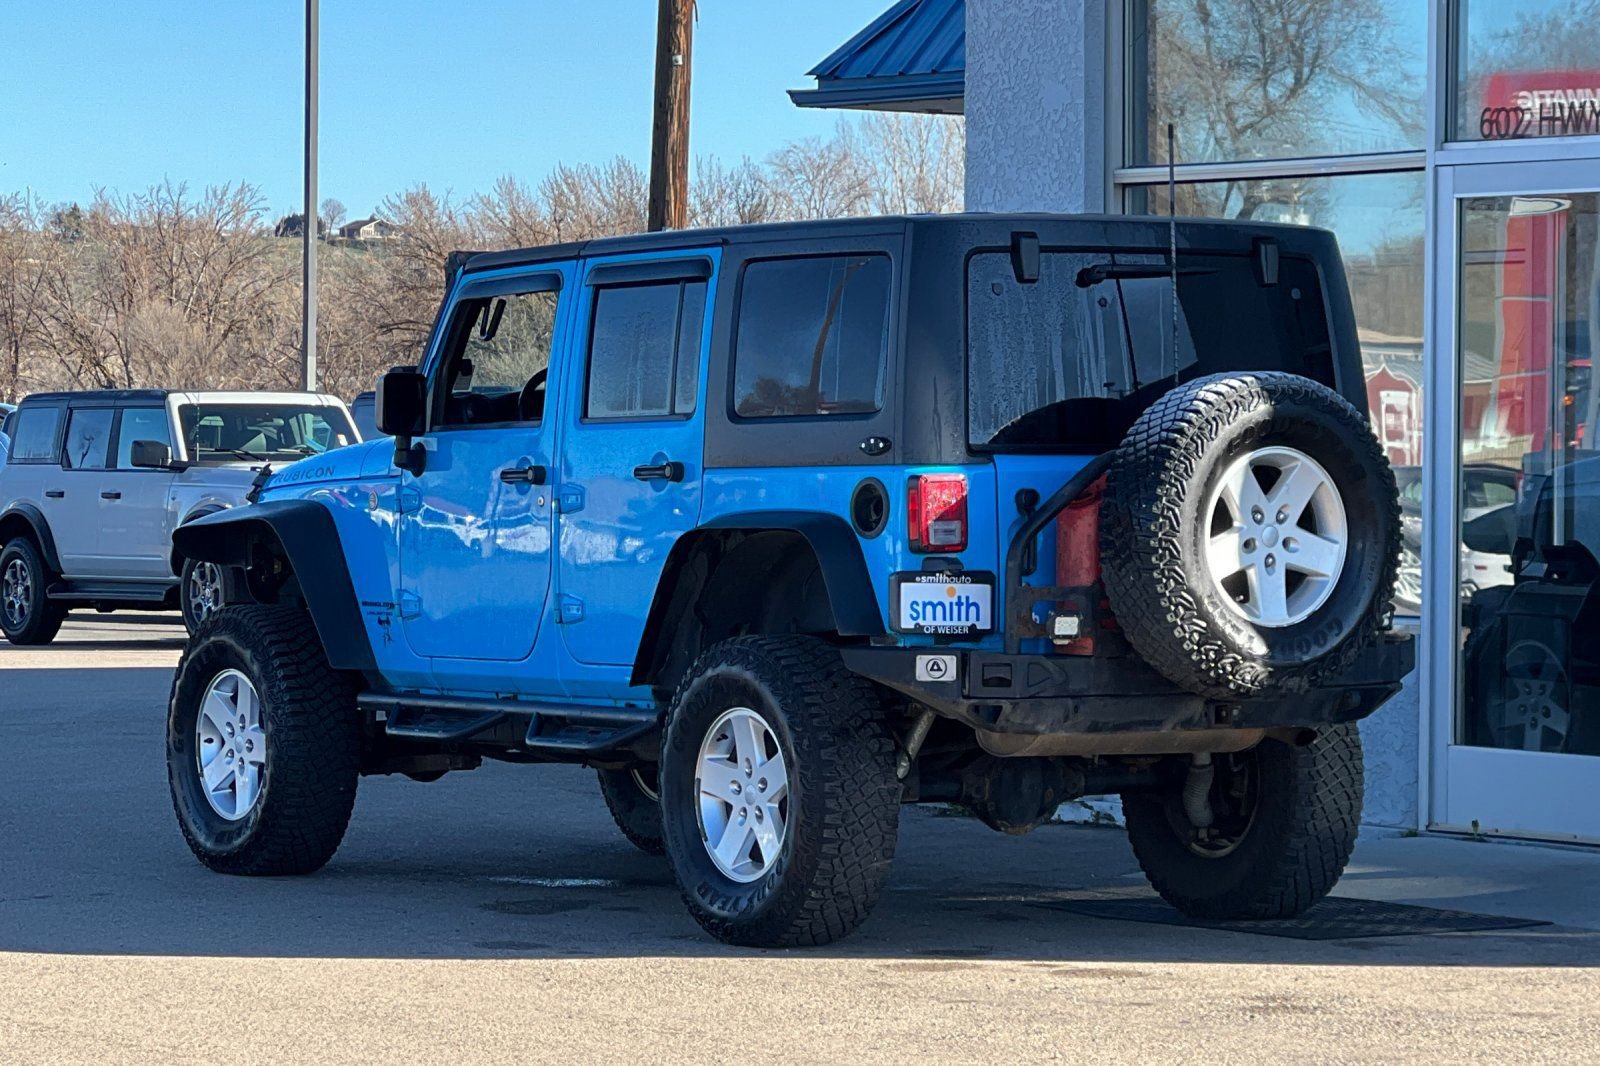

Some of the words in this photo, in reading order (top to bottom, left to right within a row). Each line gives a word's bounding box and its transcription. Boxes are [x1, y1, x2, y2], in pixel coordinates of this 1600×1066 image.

[274, 465, 336, 484] RUBICON
[920, 573, 972, 584] smithauto
[909, 586, 980, 622] smith
[923, 625, 935, 634] OF
[937, 625, 969, 635] WEISER
